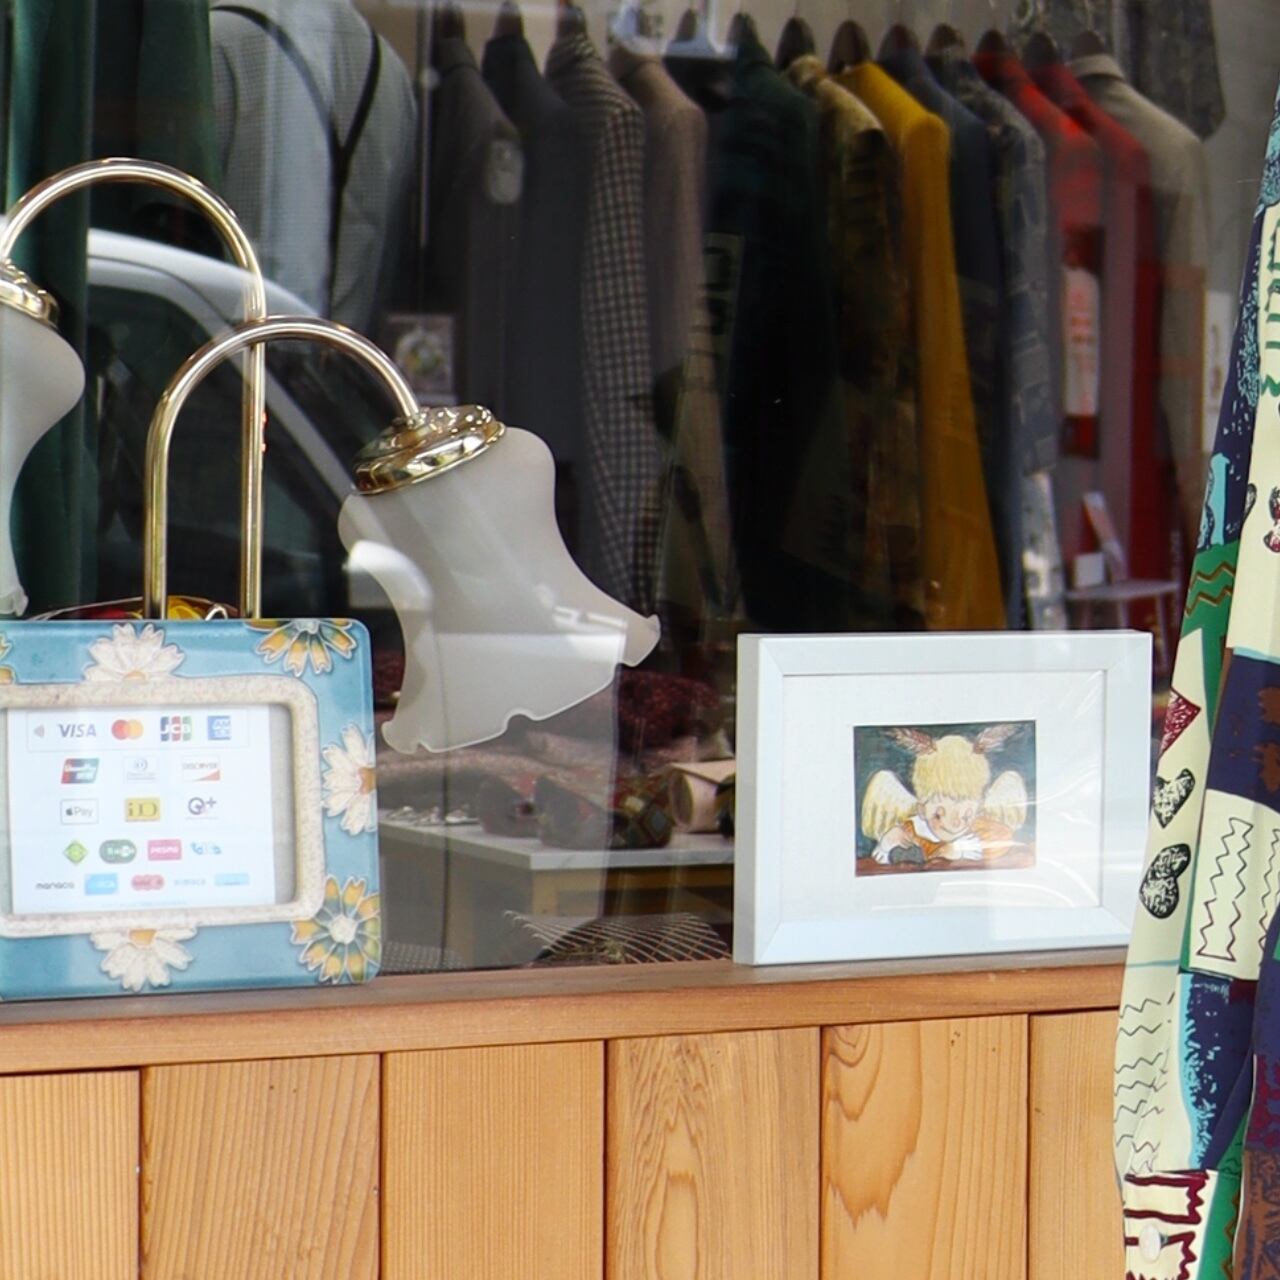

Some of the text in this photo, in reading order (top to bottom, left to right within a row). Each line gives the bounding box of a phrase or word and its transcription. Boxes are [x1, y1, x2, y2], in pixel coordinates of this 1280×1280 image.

[58, 723, 97, 738] VISA
[74, 806, 93, 817] Pay
[128, 802, 158, 817] iD
